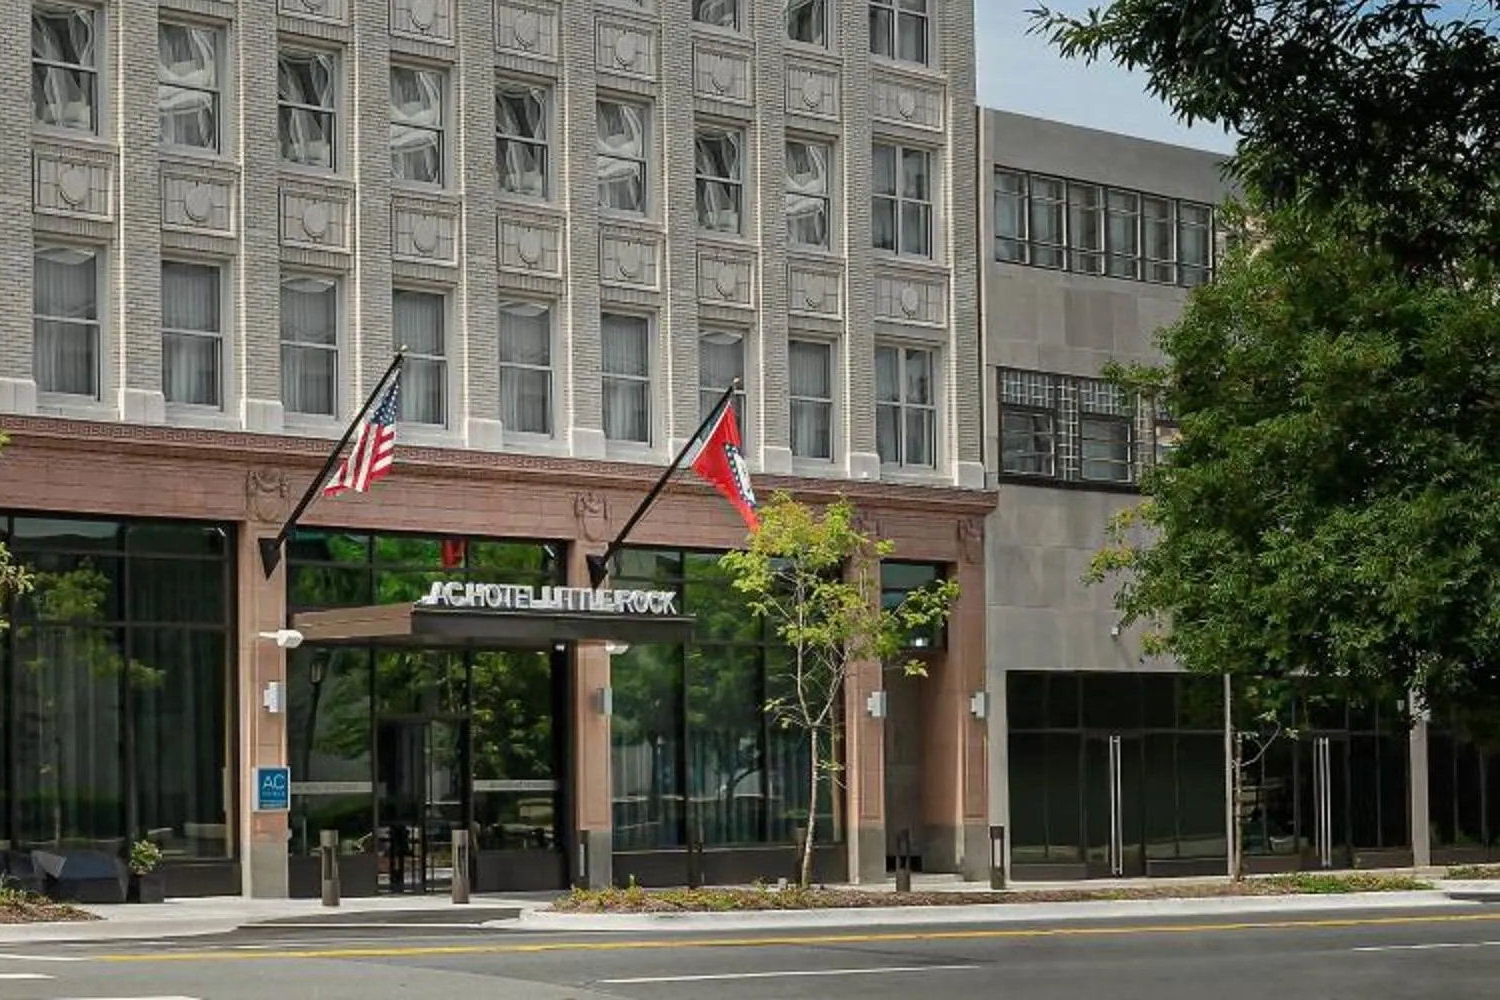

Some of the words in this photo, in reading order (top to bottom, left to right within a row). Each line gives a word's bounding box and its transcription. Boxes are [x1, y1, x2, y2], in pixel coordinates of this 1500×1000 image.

[428, 581, 464, 607] AC
[465, 583, 543, 609] HOTEL
[541, 585, 615, 612] LITTLE
[614, 589, 677, 615] ROCK
[262, 774, 285, 789] AC
